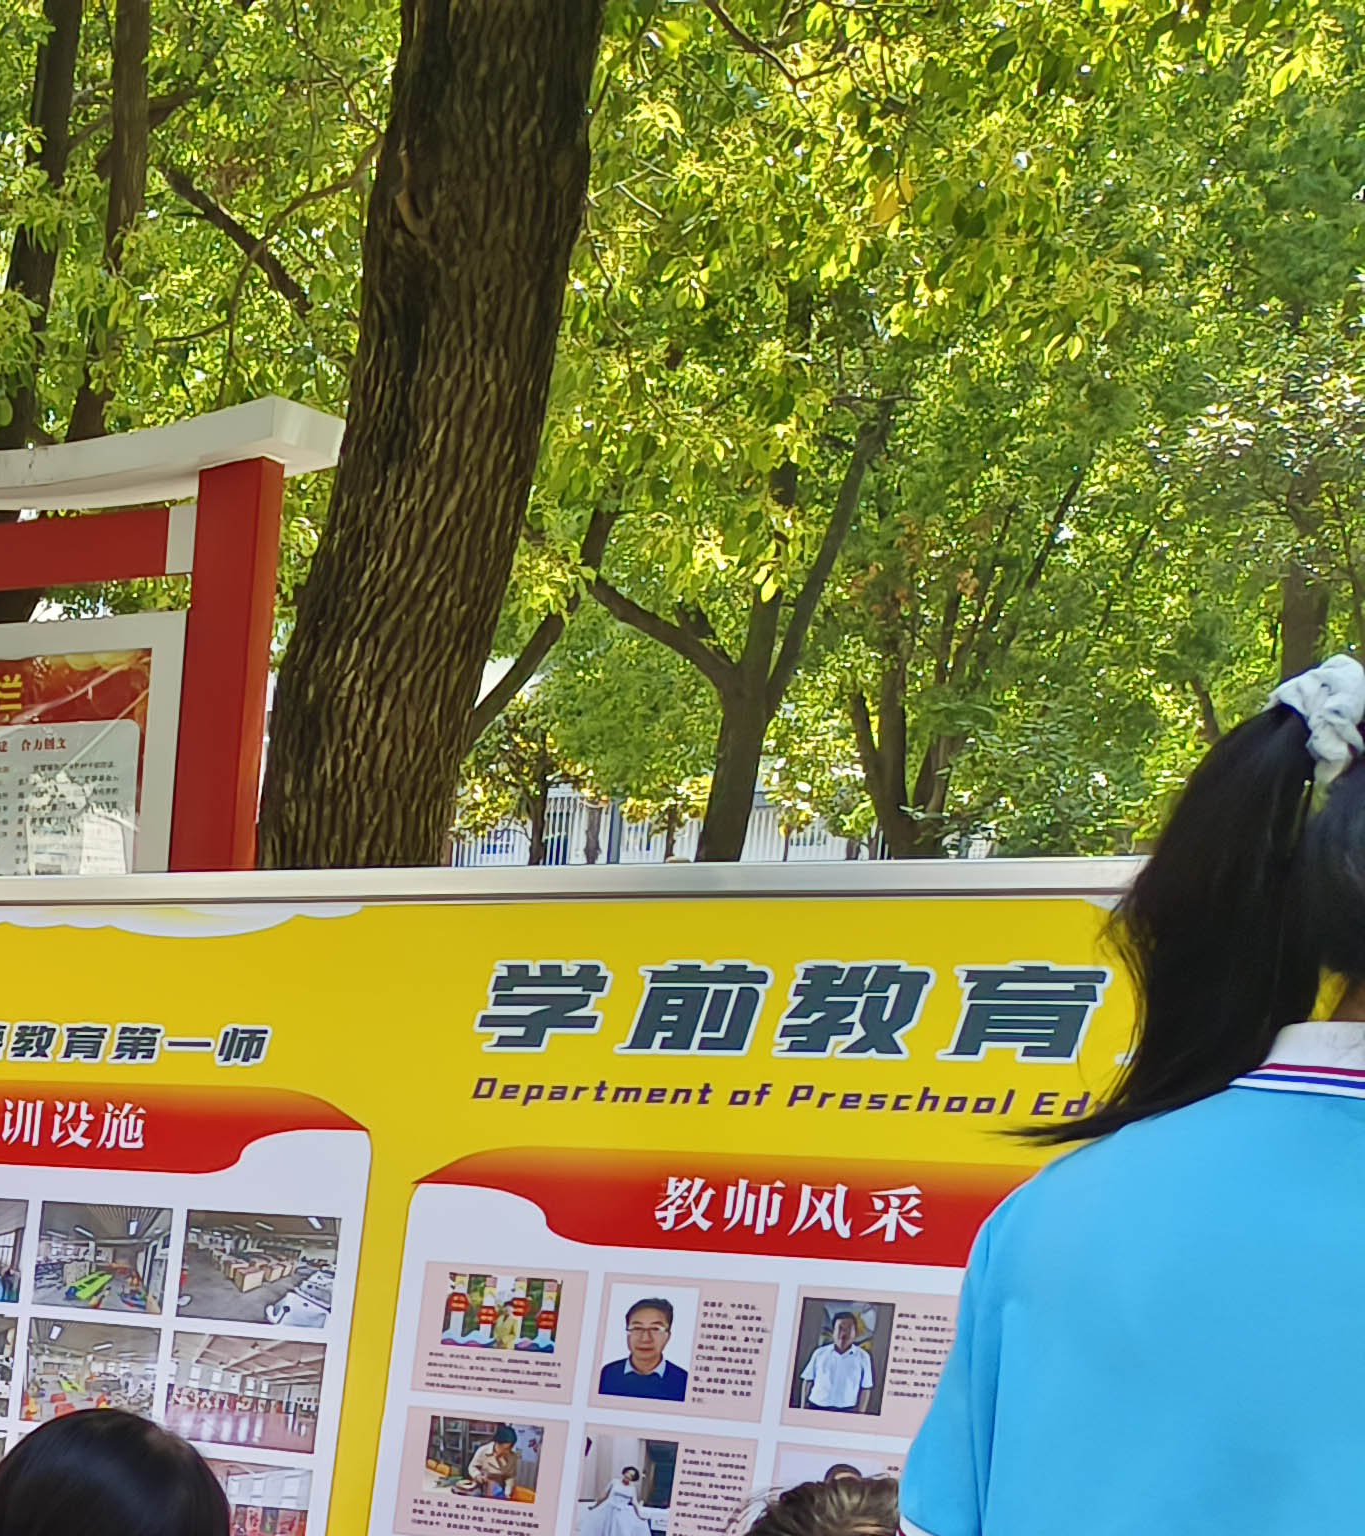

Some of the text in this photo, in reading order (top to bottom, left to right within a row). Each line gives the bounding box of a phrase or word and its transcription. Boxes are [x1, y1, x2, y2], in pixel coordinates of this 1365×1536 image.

[474, 960, 1113, 1065] 学前教育
[472, 1076, 1091, 1117] Department of Preschool Ed
[654, 1175, 924, 1242] 教师风采
